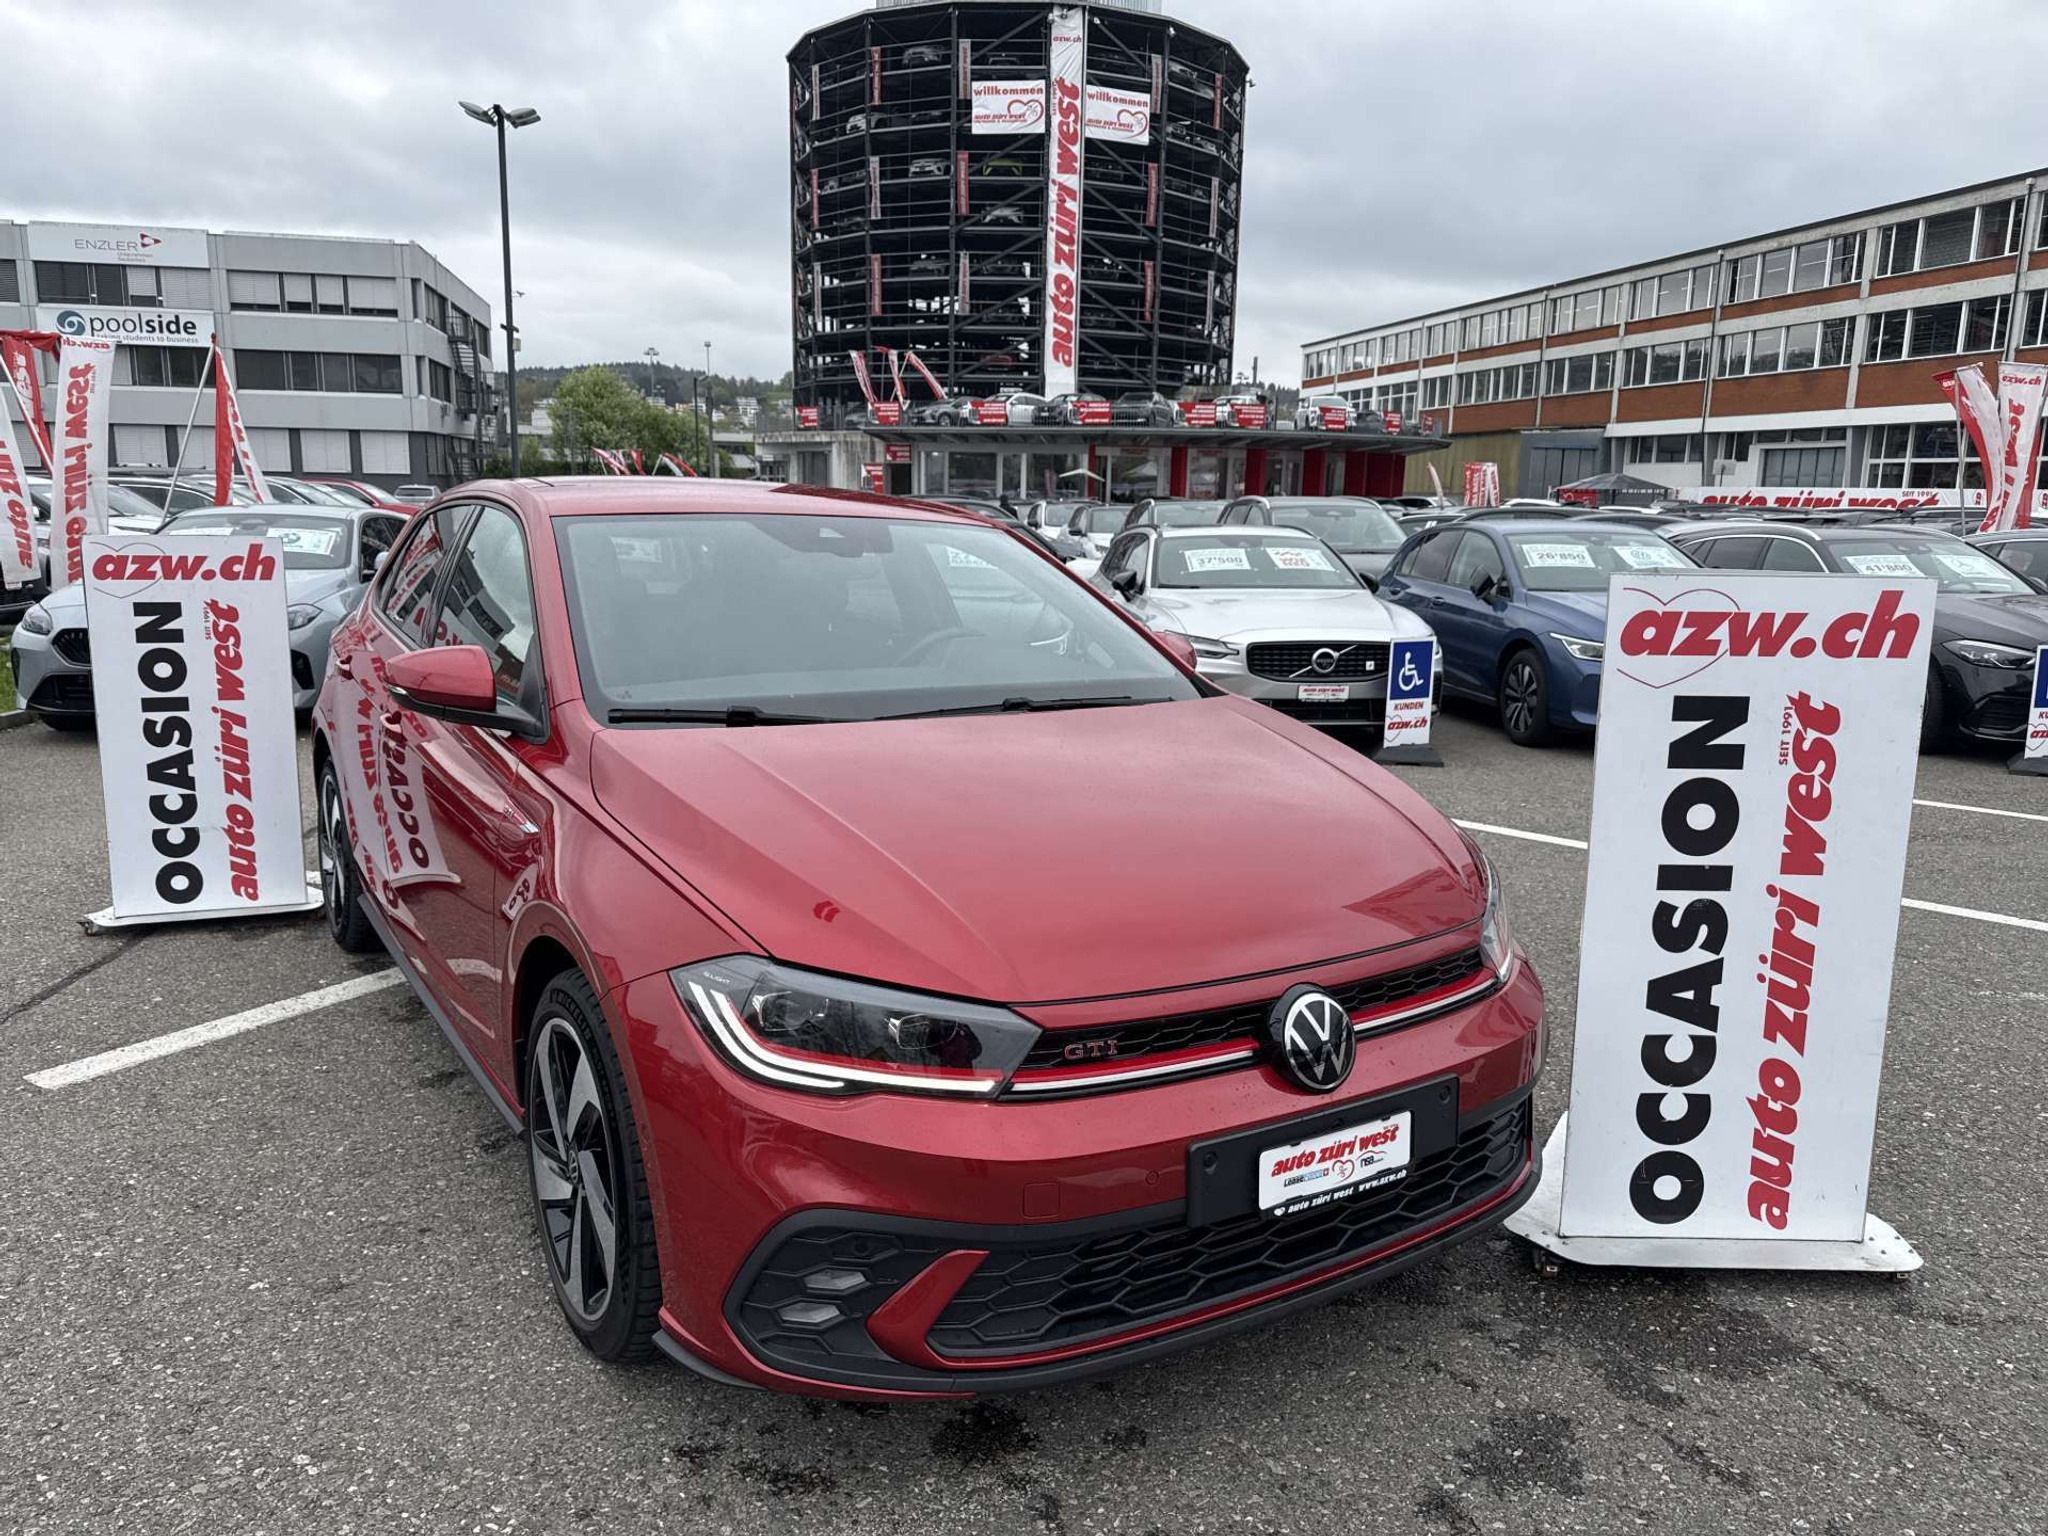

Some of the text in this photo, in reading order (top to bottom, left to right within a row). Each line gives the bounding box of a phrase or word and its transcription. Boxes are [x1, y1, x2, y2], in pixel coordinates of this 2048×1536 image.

[974, 85, 1043, 96] willkommen
[1087, 91, 1148, 107] willkommen
[1049, 76, 1080, 367] auto züri west
[74, 239, 138, 251] ENZLER
[89, 313, 197, 337] poolside
[166, 336, 199, 344] business
[92, 543, 276, 582] azw.ch
[1618, 589, 1921, 660] azw.ch
[1394, 701, 1424, 711] KUNDEN
[1387, 717, 1427, 731] azw.ch
[1779, 704, 1793, 766] SEIT 1991
[133, 601, 204, 904] OCCASION
[206, 599, 259, 901] auto züri west
[1629, 695, 1751, 1225] OCCASION
[1745, 691, 1842, 1231] auto züri west
[1064, 1040, 1118, 1060] GTI
[1271, 1125, 1400, 1178] auto züri west
[1288, 1200, 1309, 1213] auto
[1312, 1192, 1331, 1205] züri
[1333, 1186, 1354, 1200] west
